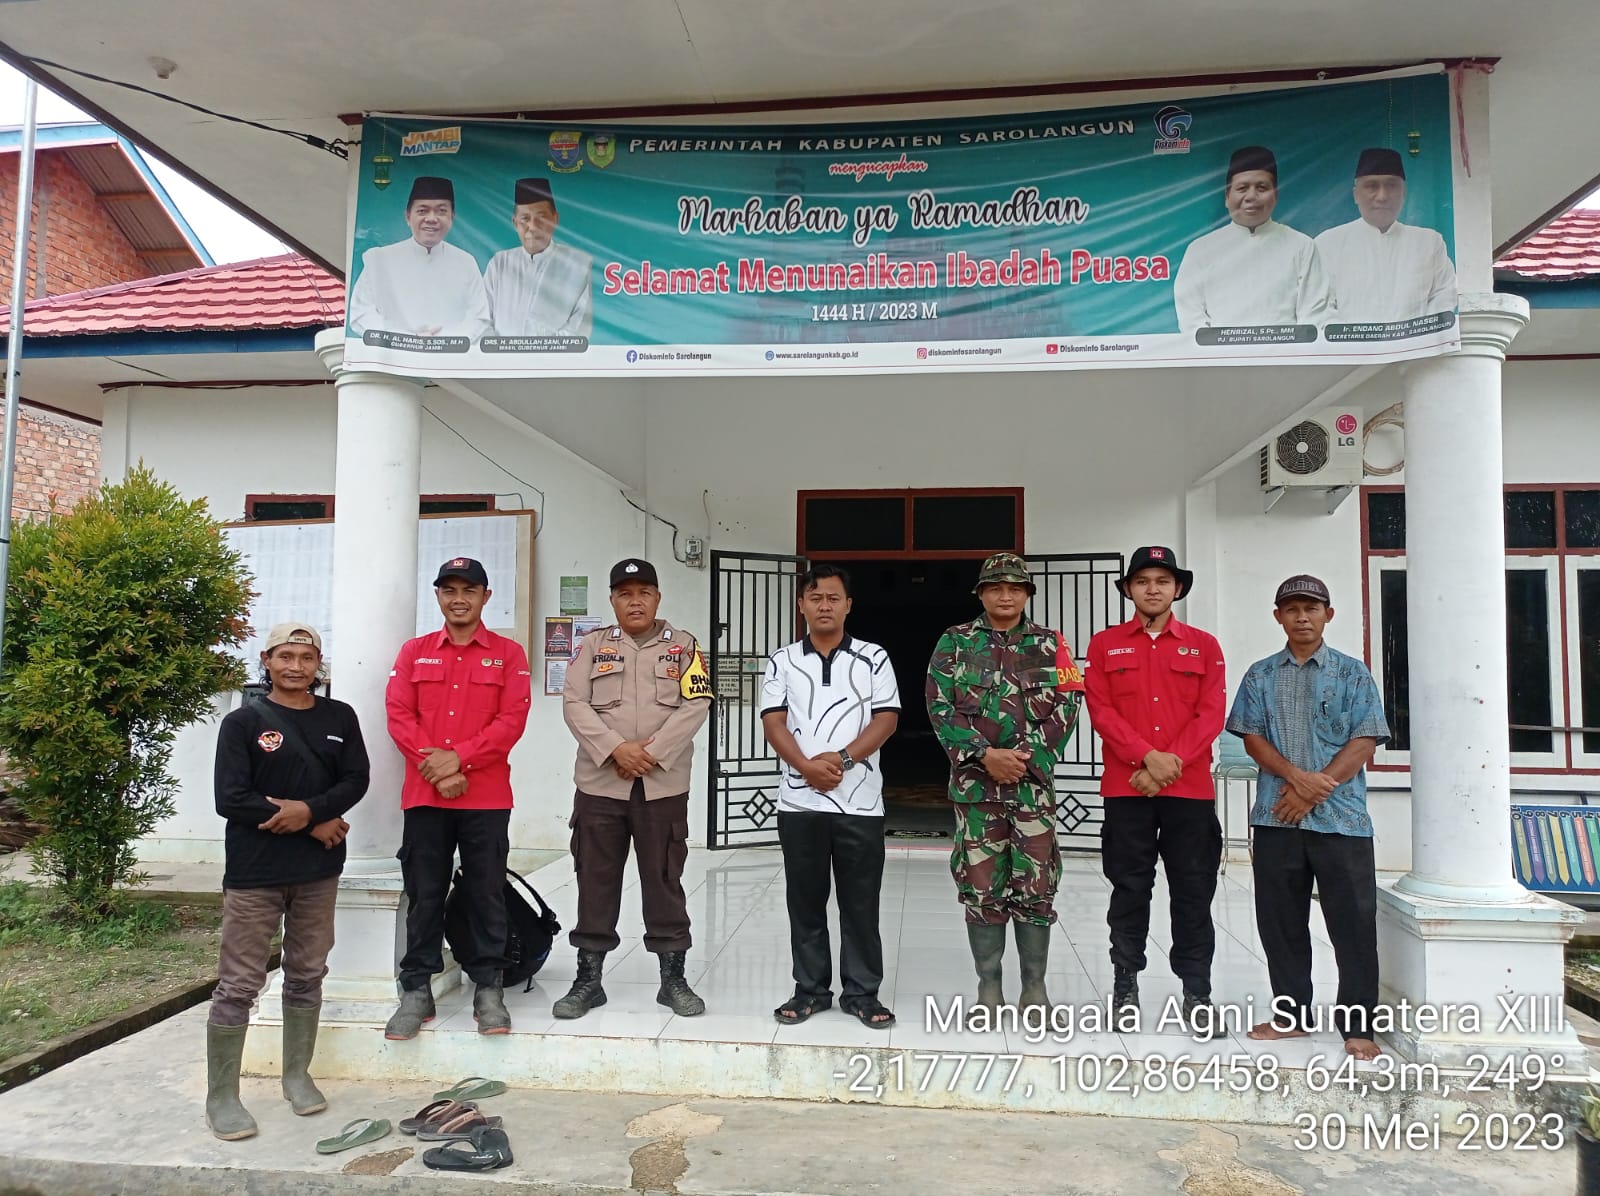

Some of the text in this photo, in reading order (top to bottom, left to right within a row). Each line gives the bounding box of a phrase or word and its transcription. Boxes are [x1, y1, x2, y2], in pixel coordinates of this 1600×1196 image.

[629, 120, 1135, 153] PEMERINTAH KABUPATEN SAROLANGUN
[402, 140, 460, 155] MANTAP
[829, 153, 928, 182] mengucapkan
[678, 185, 1089, 248] Marhaban ya Ramadhan
[603, 248, 1170, 296] Selamat Menunaikan Ibadah Puasa
[811, 304, 848, 322] 1444
[851, 303, 866, 320] H
[879, 302, 917, 319] 2023
[921, 302, 938, 319] M
[1385, 323, 1411, 331] ABDUL
[1412, 316, 1439, 327] NASER
[1060, 343, 1139, 353] Diskominfo Sarolangun
[639, 352, 712, 362] Diskominfo Sarolangun
[1338, 437, 1355, 447] LG
